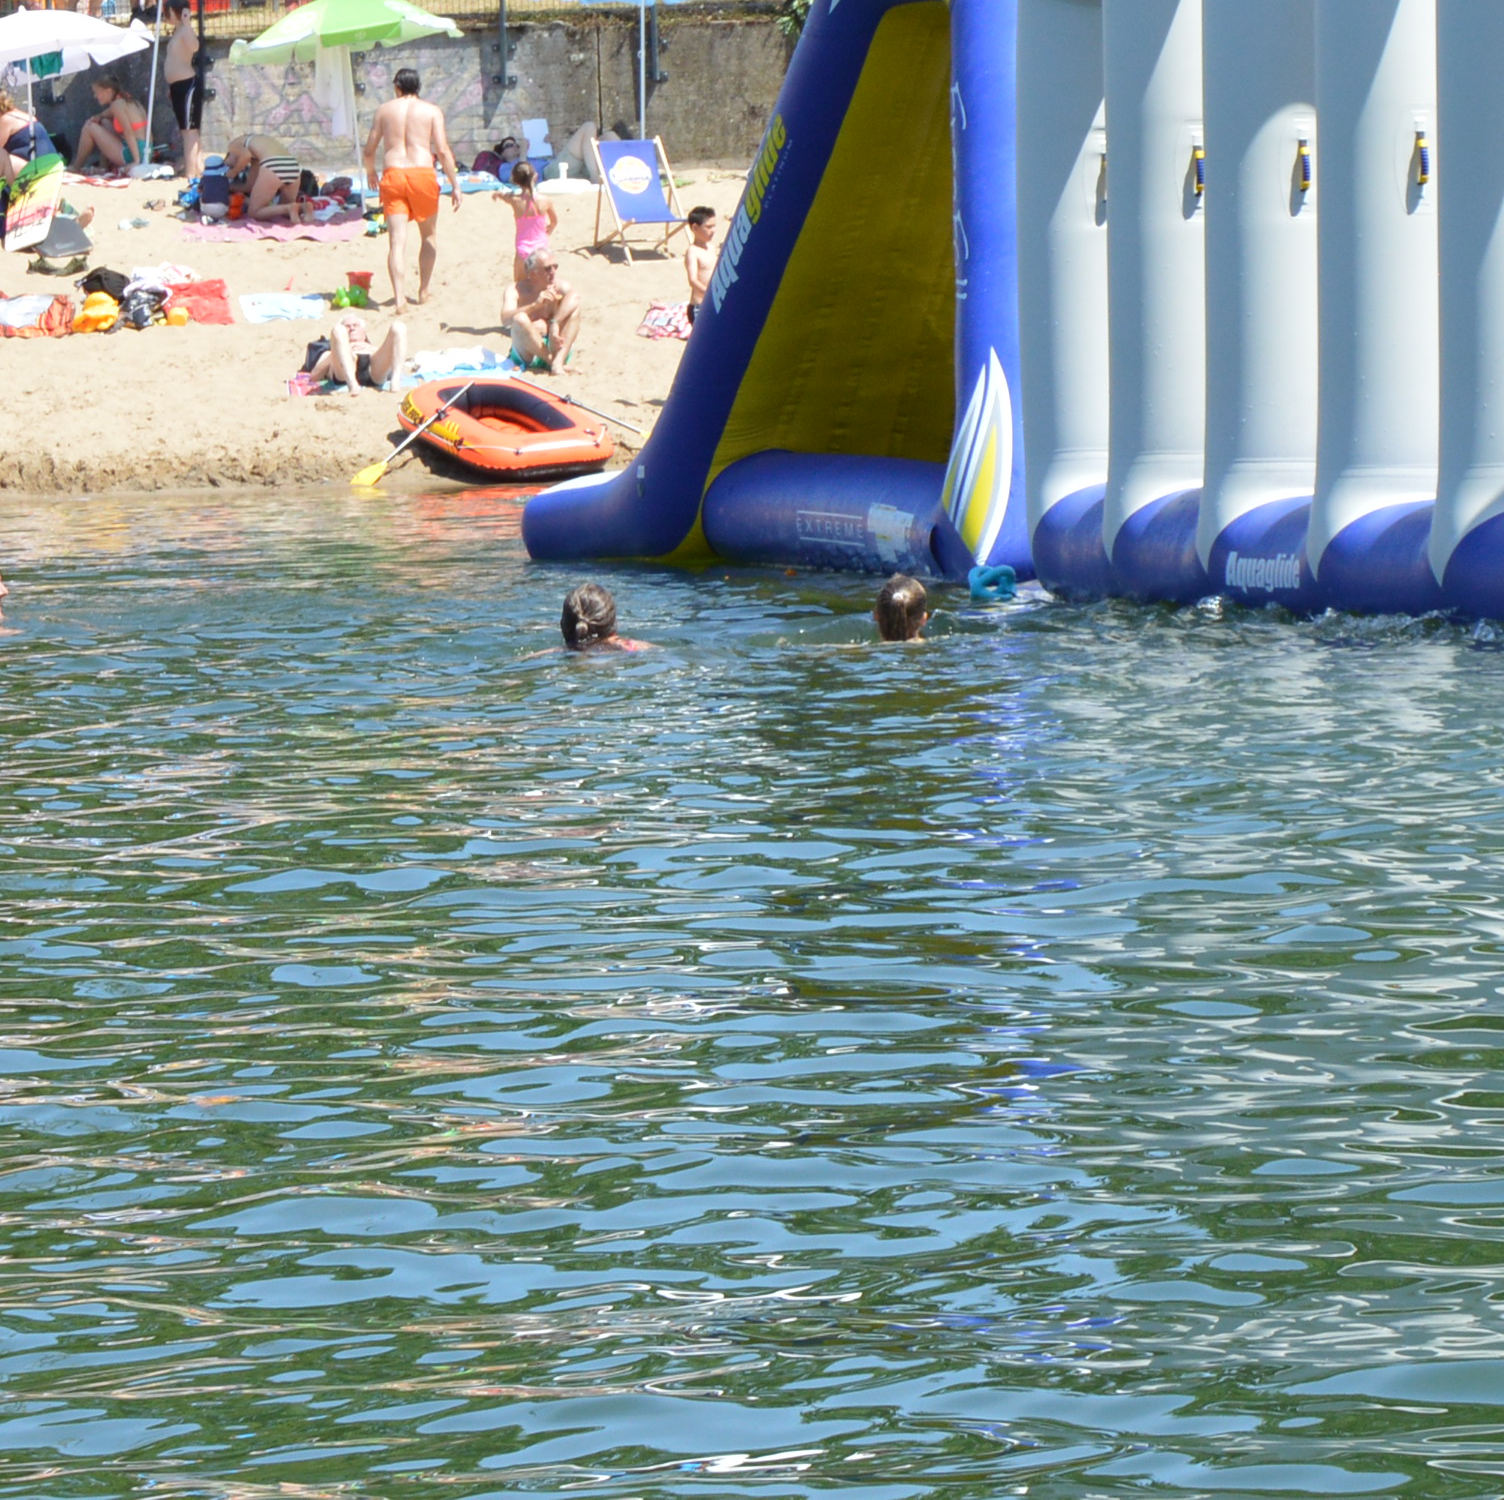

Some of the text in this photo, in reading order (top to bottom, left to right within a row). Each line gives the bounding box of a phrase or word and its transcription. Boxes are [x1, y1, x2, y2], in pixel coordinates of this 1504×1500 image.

[710, 112, 787, 315] Aquaglide
[795, 517, 864, 540] EXTREME
[1225, 551, 1301, 594] Aquaglide
